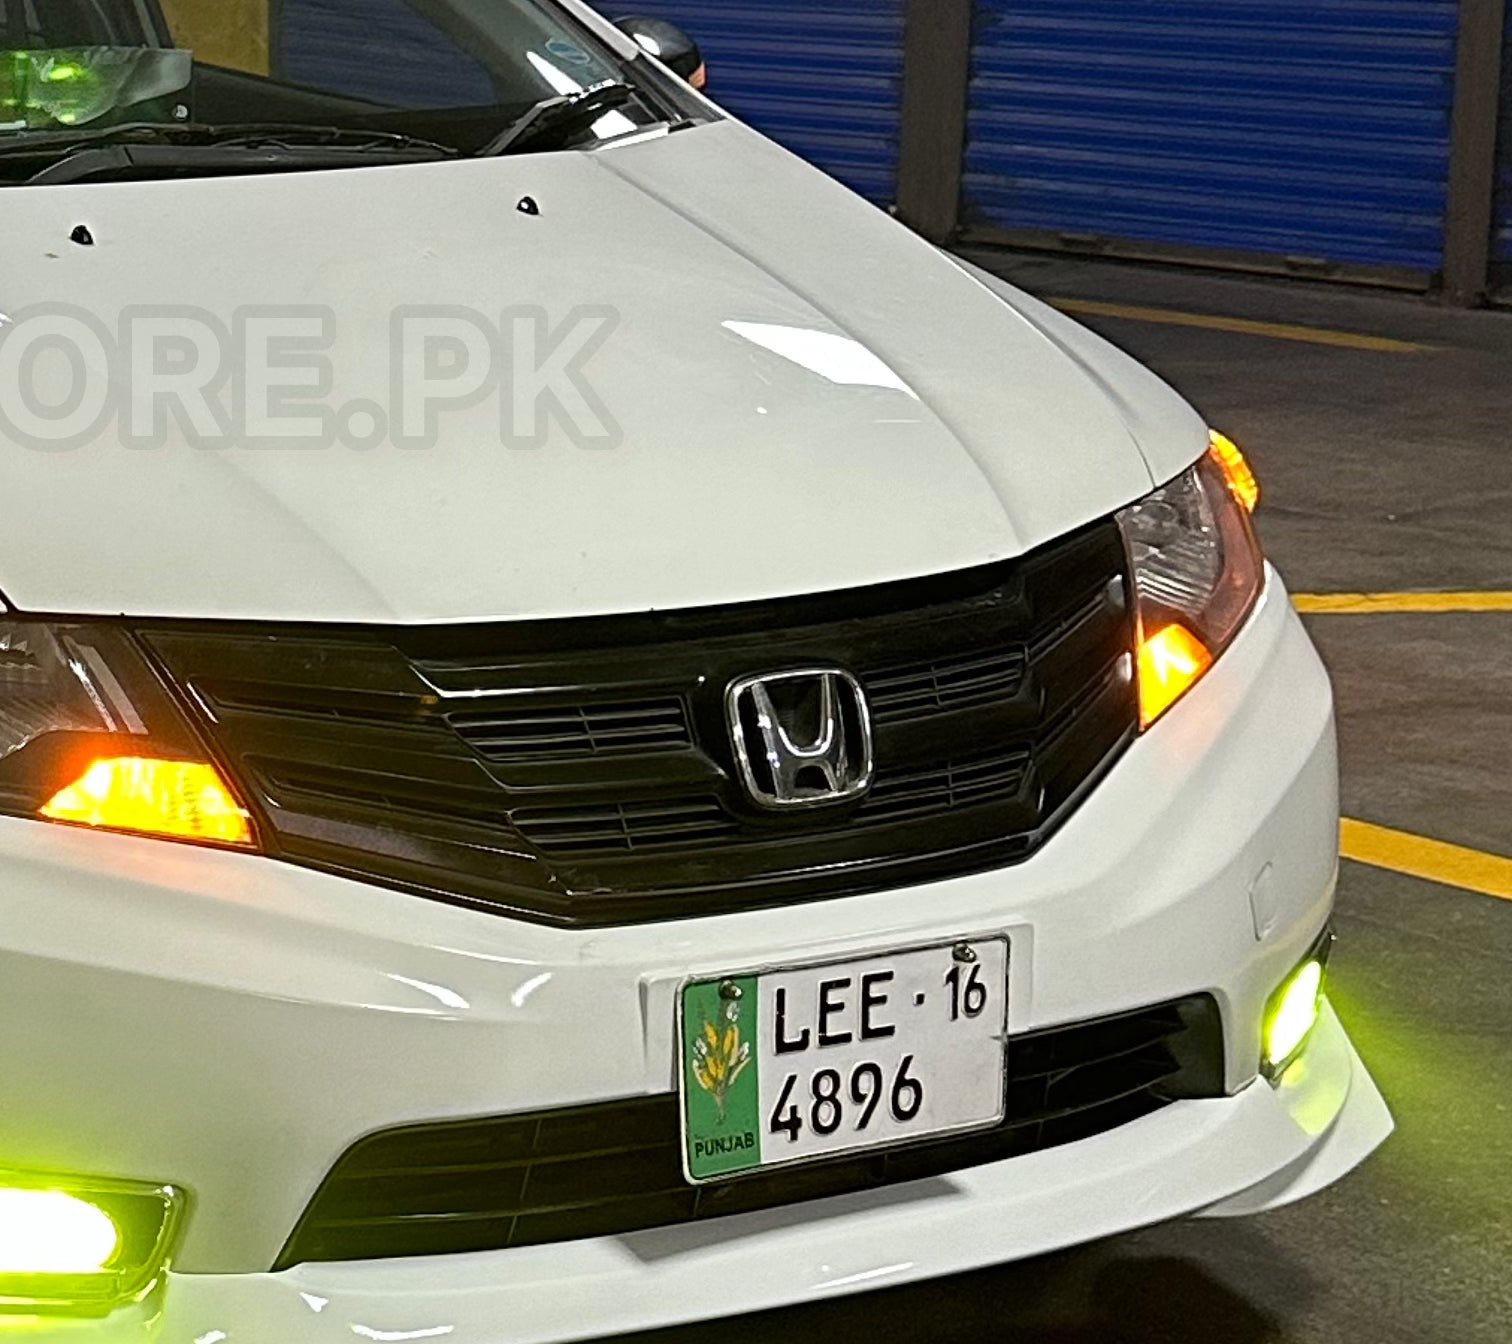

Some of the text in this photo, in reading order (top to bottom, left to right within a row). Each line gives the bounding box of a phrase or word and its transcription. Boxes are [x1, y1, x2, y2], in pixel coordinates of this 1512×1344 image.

[774, 963, 988, 1056] LEE 16
[770, 1054, 923, 1143] 4896
[694, 1131, 755, 1158] PUNJAB
